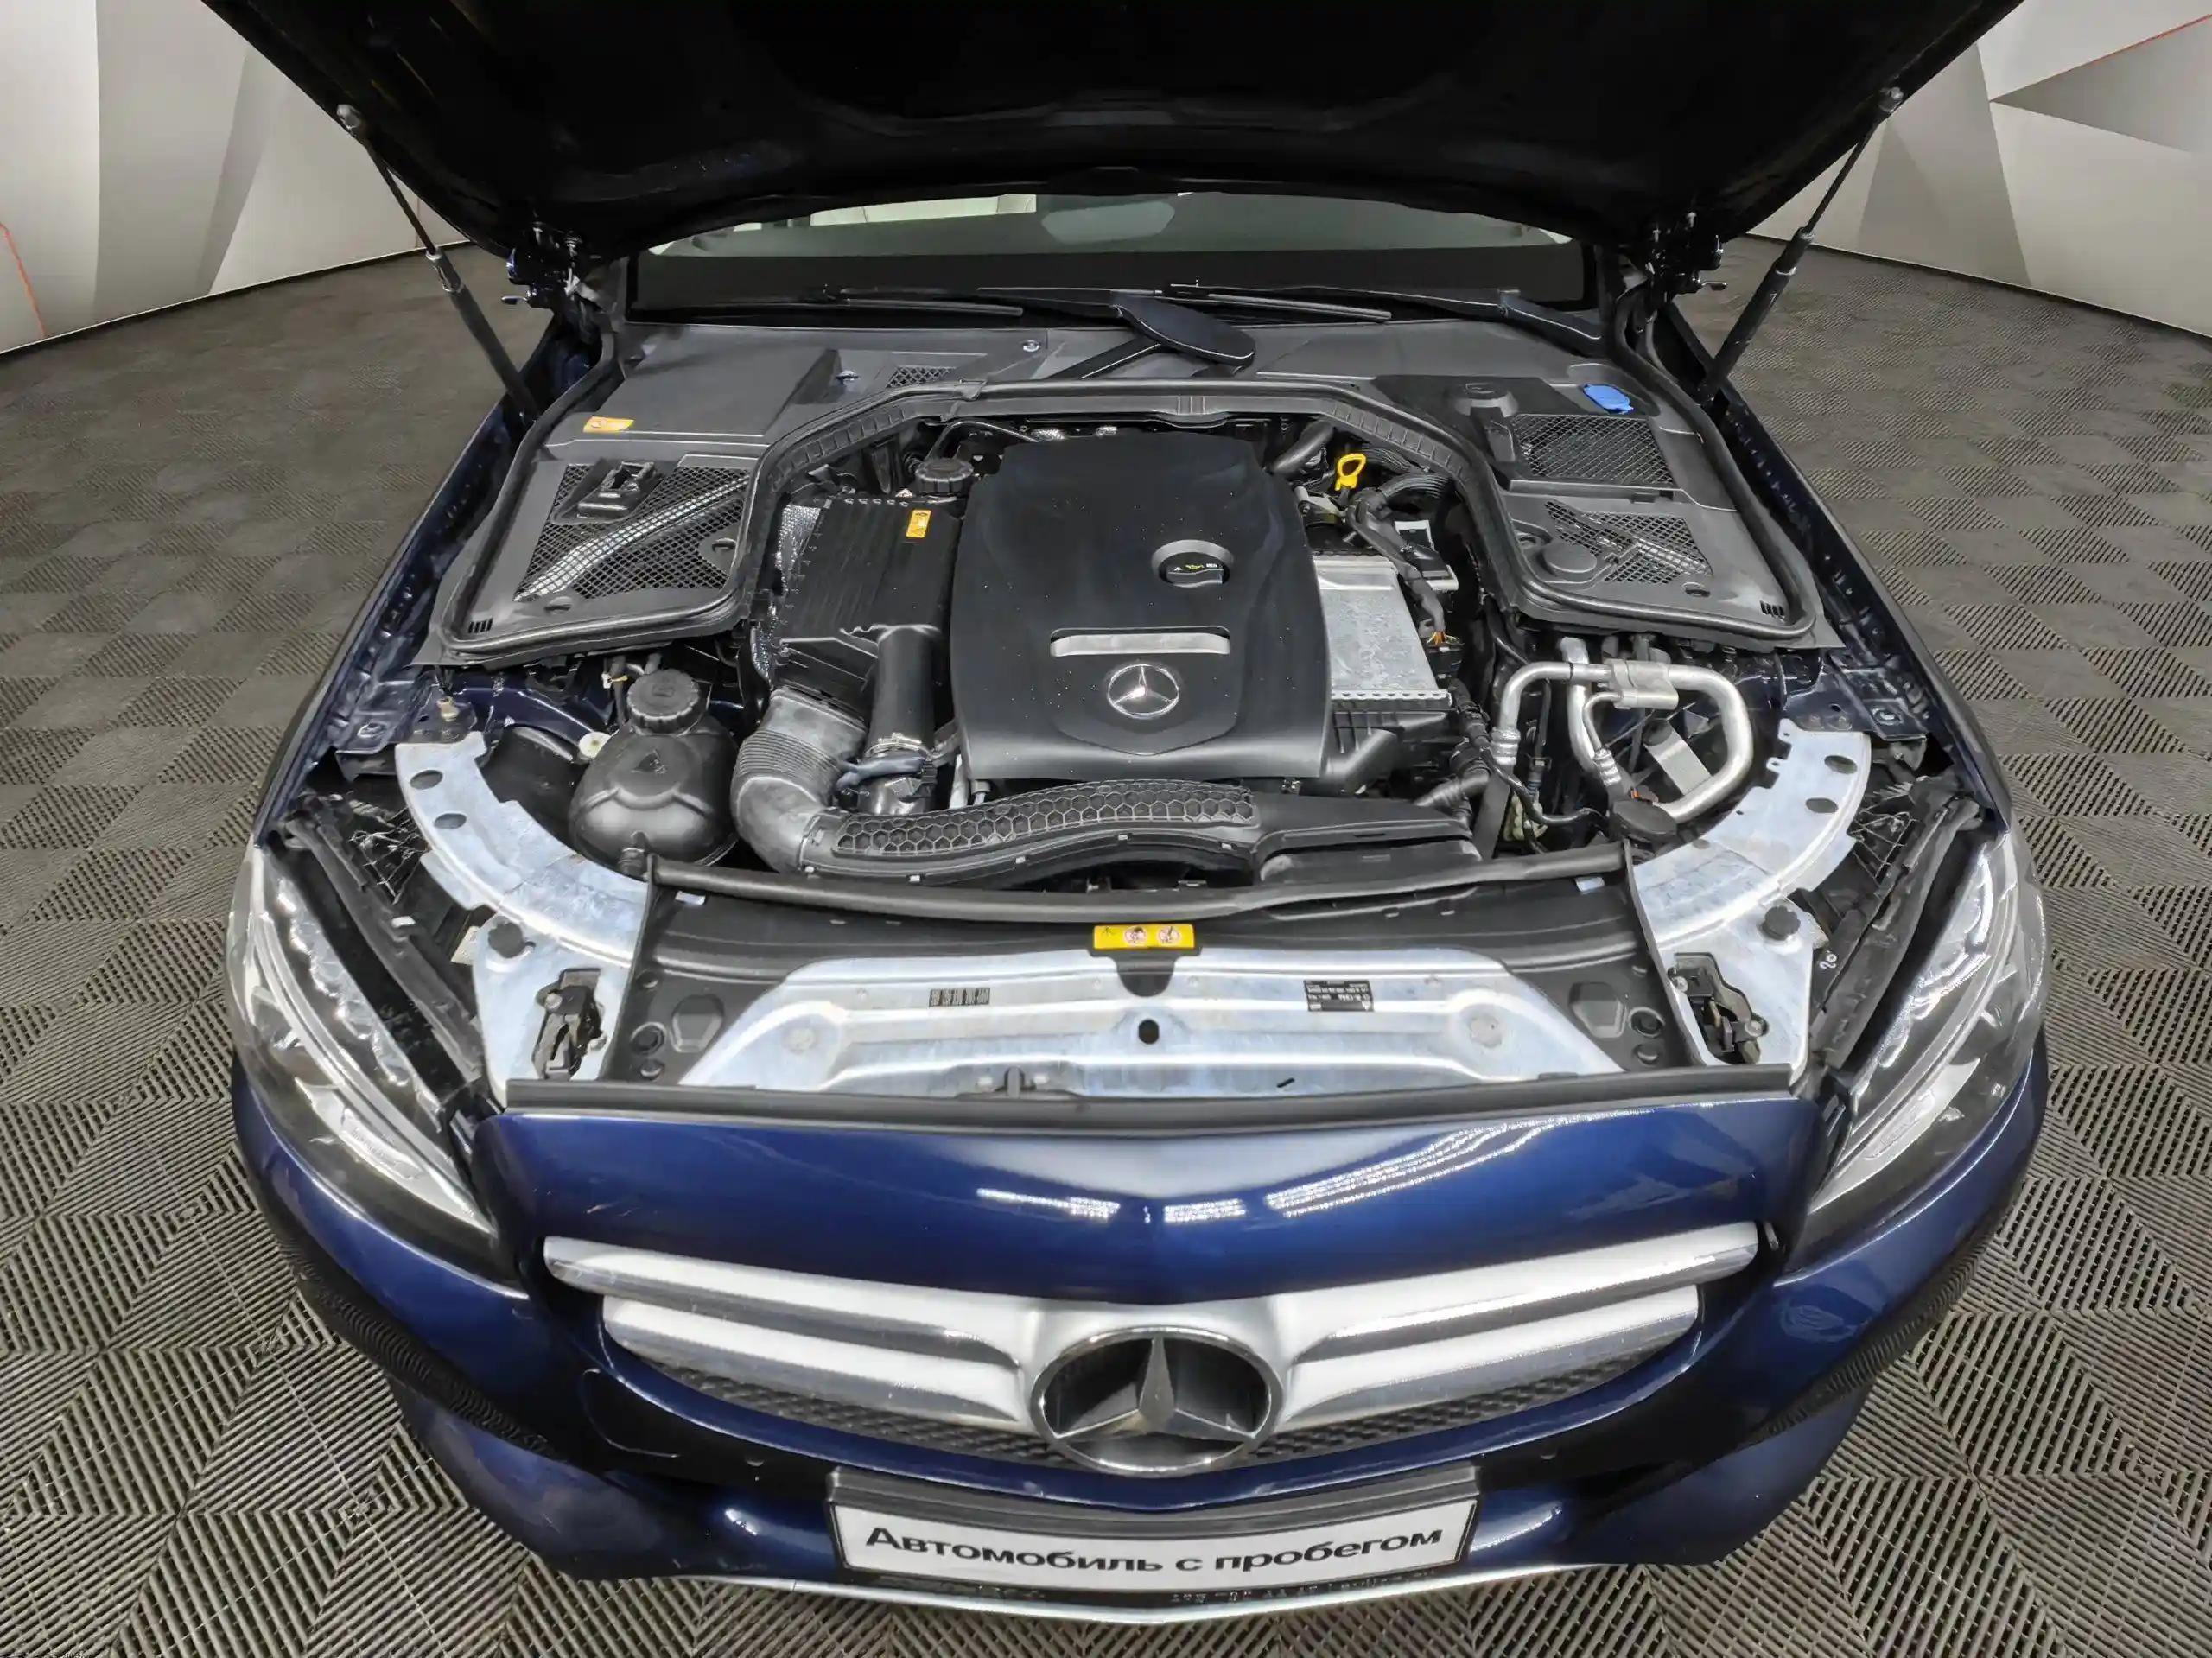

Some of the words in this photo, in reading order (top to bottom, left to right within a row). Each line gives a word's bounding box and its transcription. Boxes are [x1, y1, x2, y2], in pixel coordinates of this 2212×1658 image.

[866, 1528, 1164, 1571] Автомобиль
[1175, 1558, 1203, 1571] с
[1215, 1529, 1443, 1572] пробегом
